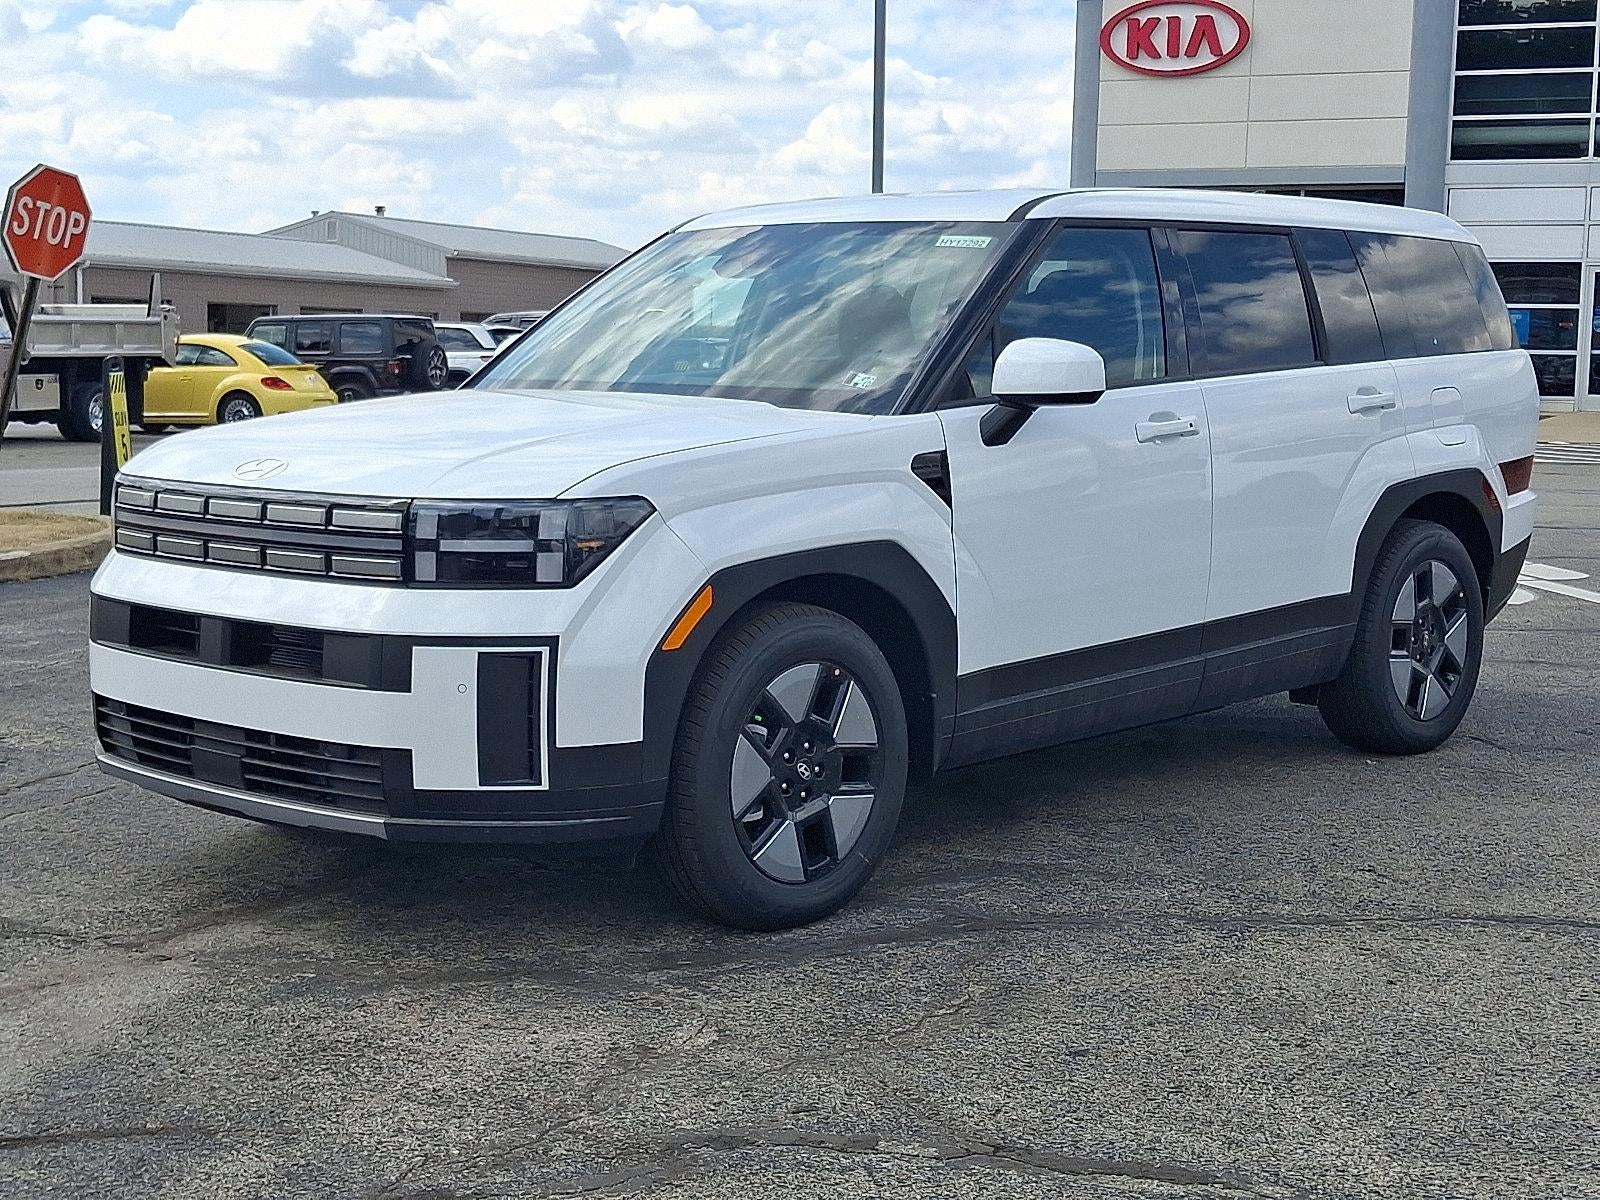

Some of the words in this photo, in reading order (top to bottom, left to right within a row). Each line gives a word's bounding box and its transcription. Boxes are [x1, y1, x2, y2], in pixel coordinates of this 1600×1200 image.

[1126, 14, 1224, 60] KIA
[12, 195, 86, 249] STOP
[939, 238, 986, 248] HY17292
